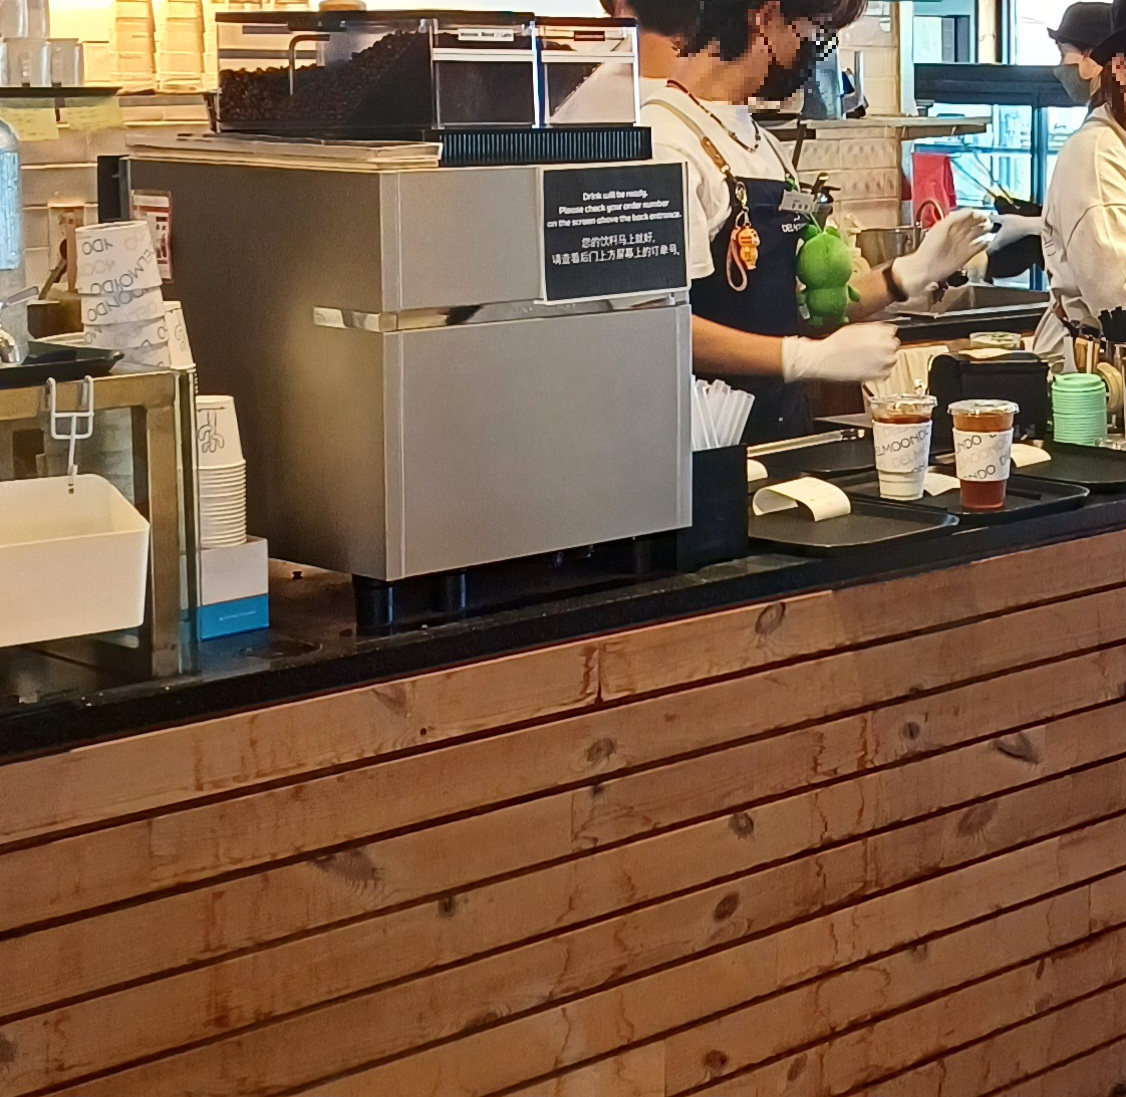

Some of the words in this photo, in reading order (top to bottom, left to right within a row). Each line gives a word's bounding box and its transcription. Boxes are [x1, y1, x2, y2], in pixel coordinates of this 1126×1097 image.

[583, 191, 602, 201] Drink
[603, 190, 615, 199] will
[616, 190, 625, 199] be
[558, 206, 584, 214] Please
[585, 204, 606, 213] check
[606, 203, 622, 213] your
[623, 201, 642, 210] order
[642, 200, 670, 209] number
[572, 218, 596, 226] screen
[597, 216, 619, 225] above
[619, 214, 631, 223] the
[632, 212, 649, 221] back
